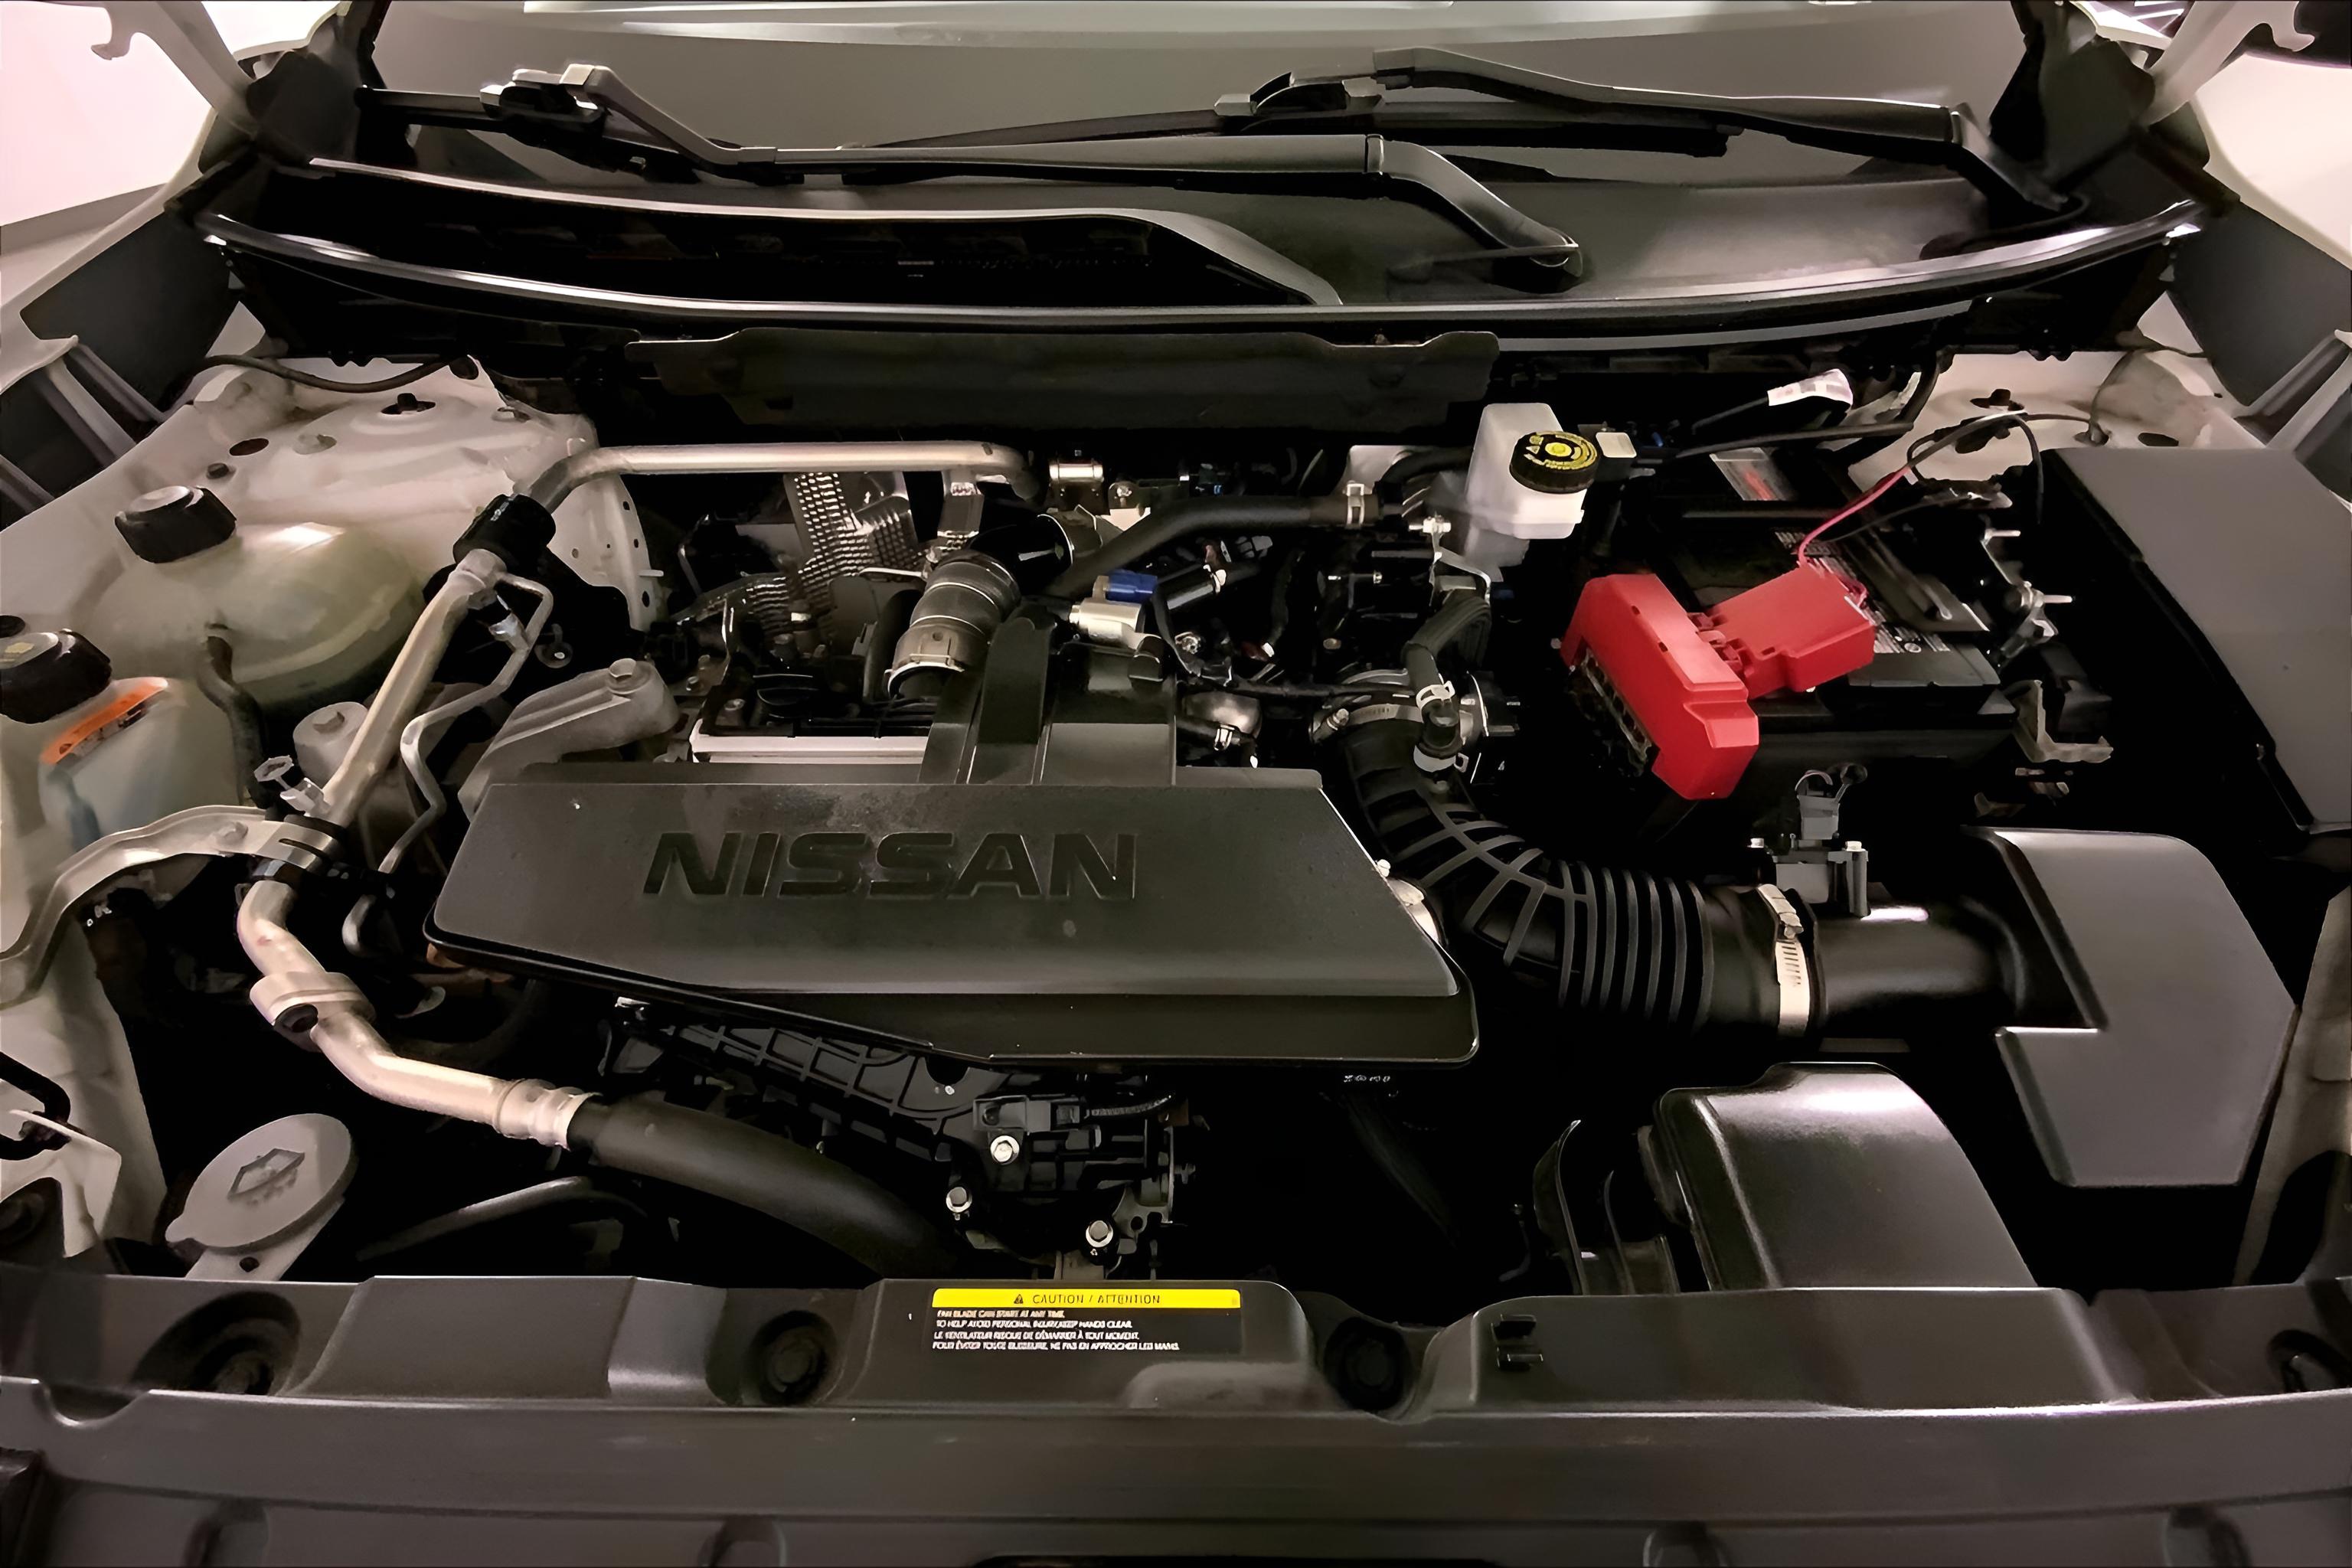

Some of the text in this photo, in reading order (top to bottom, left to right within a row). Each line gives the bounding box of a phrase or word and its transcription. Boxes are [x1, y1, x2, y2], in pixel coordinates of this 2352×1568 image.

[644, 831, 1138, 900] NISSAN
[1033, 1294, 1084, 1305] CAUTION
[1097, 1294, 1161, 1305] ATTENTION
[947, 1319, 968, 1328] HELP
